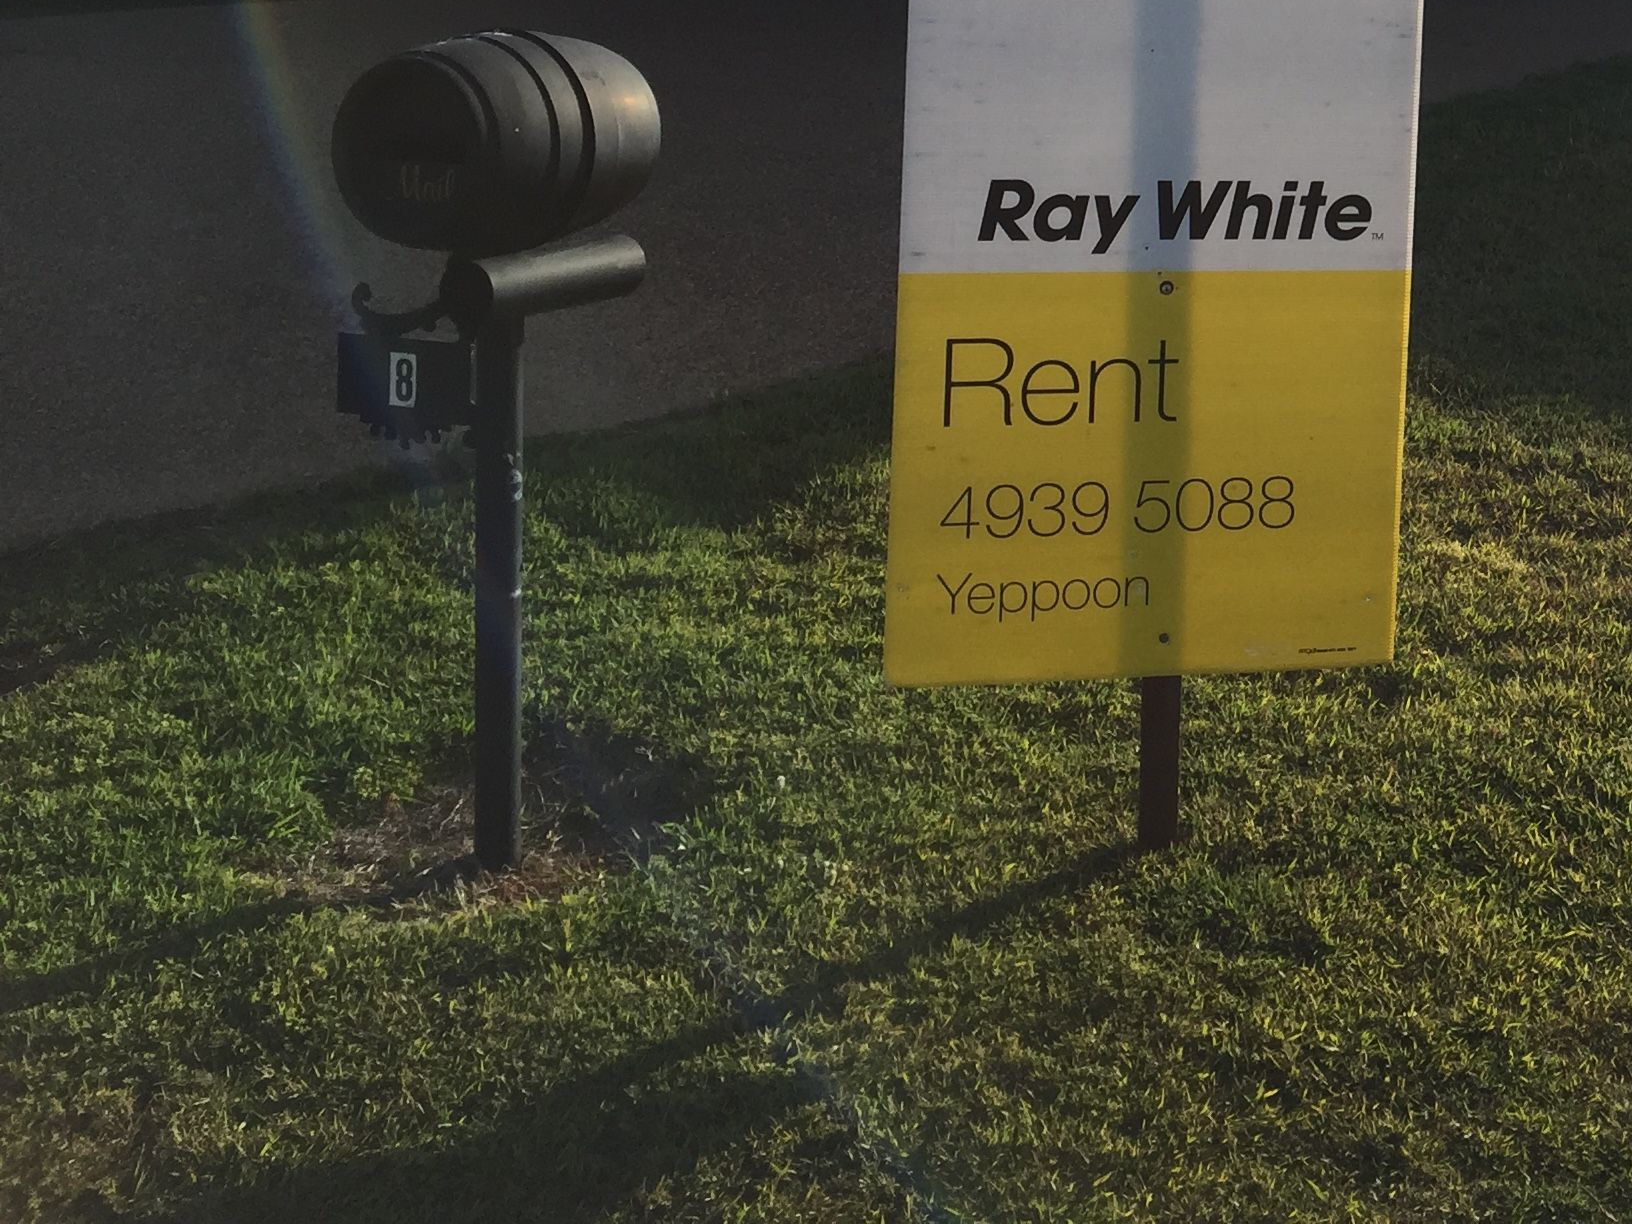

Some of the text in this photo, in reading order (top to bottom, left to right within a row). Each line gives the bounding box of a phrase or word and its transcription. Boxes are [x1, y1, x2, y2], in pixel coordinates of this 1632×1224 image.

[978, 179, 1140, 254] Ray
[1158, 180, 1372, 241] White
[396, 359, 413, 402] 8
[943, 338, 1179, 427] Rent
[939, 475, 1296, 539] 4939 5088
[937, 573, 1149, 622] Yeppoon
